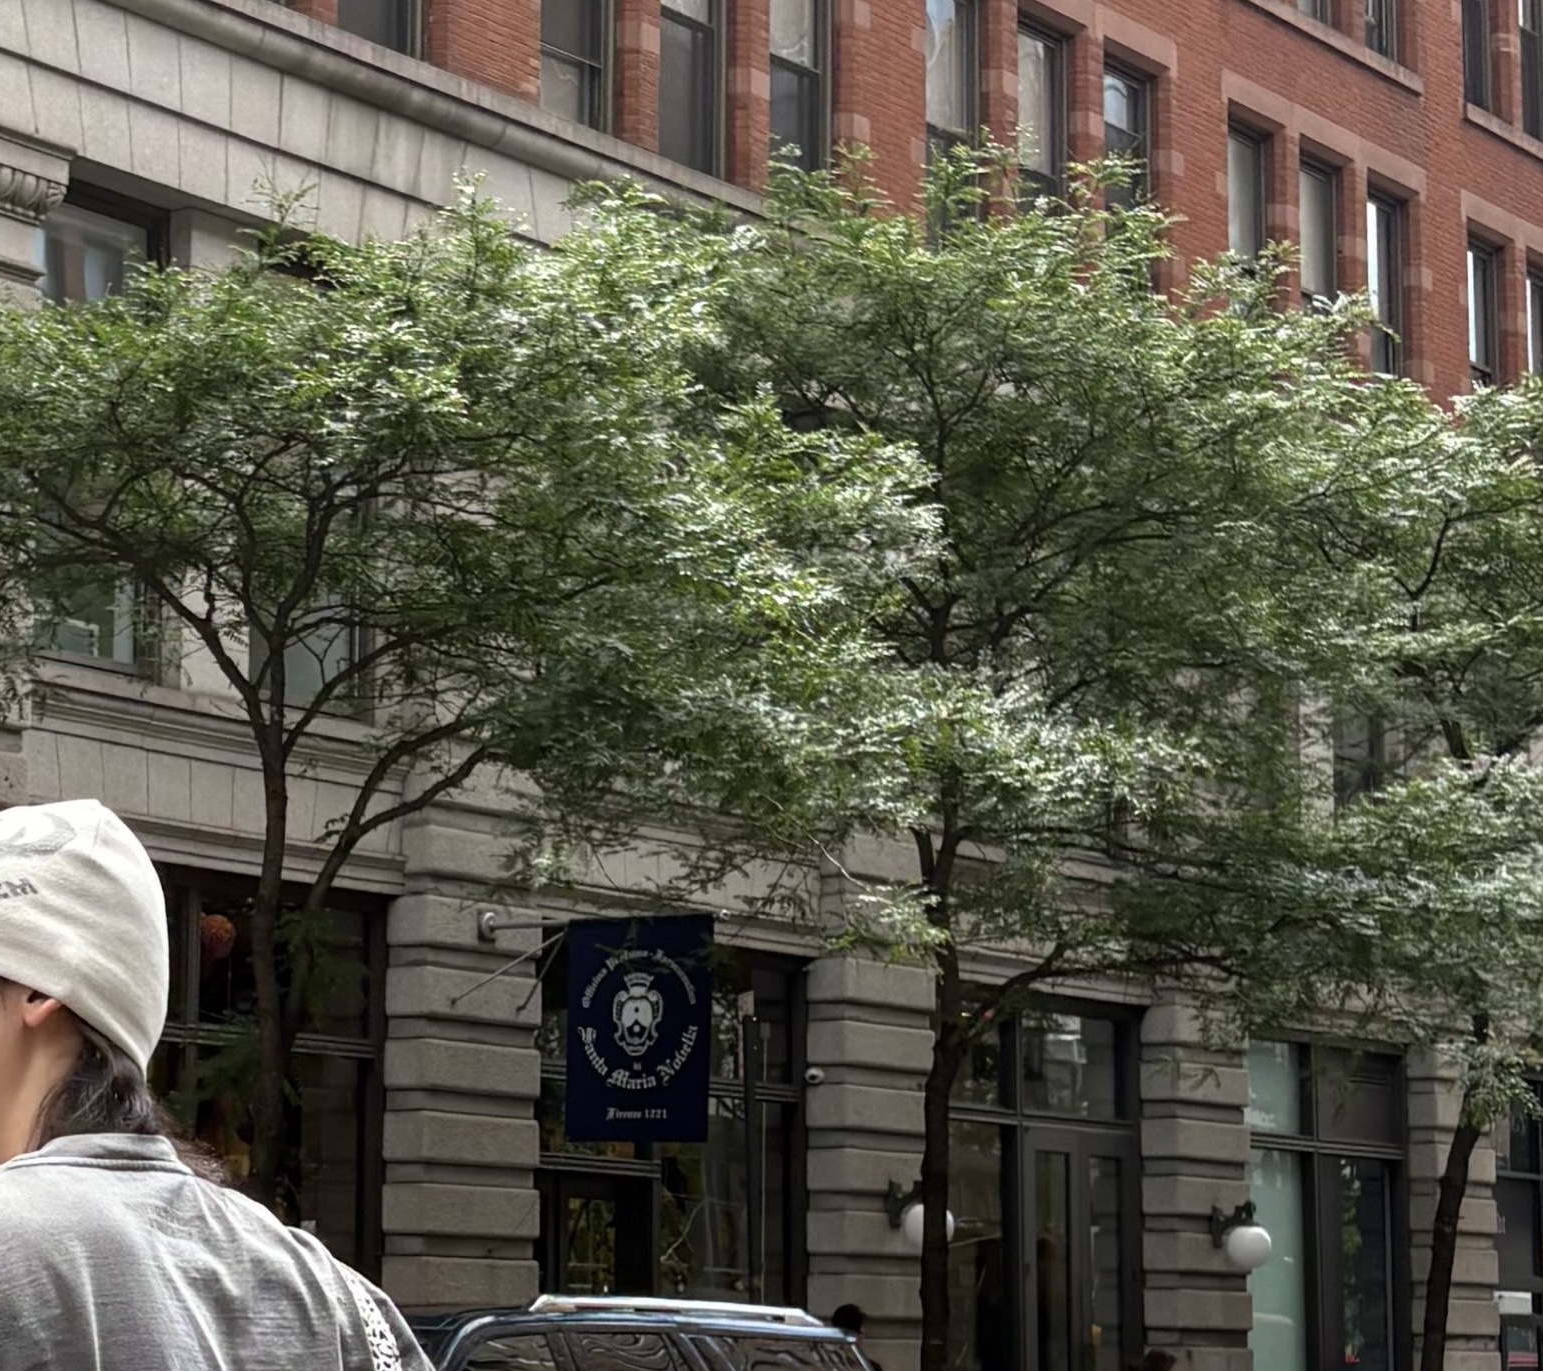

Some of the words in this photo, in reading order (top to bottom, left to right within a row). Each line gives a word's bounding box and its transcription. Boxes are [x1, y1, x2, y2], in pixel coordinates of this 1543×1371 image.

[577, 1026, 609, 1076] Santa
[606, 1068, 657, 1090] Maria
[656, 1025, 698, 1087] Novella
[644, 1108, 667, 1119] 1221
